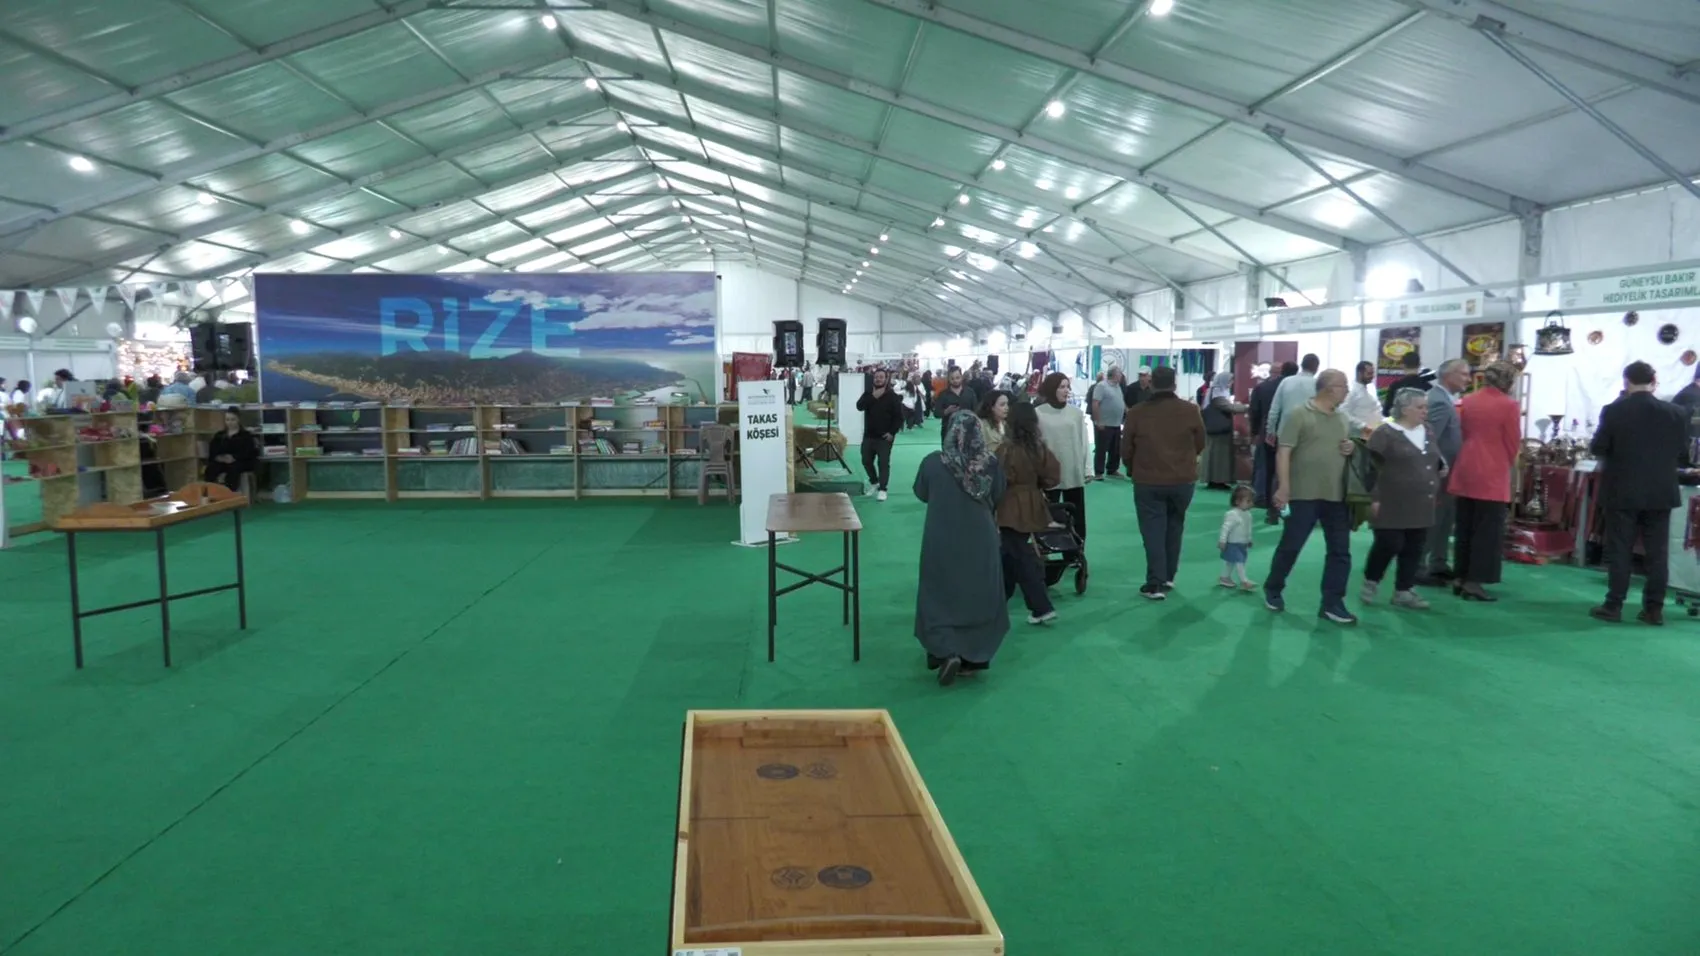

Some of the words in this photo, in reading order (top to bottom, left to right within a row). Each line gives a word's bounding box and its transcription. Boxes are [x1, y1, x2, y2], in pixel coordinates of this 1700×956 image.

[1619, 276, 1663, 288] GÜNEYSU
[1664, 271, 1696, 284] BAKIR
[747, 413, 778, 424] TAKAS
[746, 426, 779, 440] KÖŞESİ
